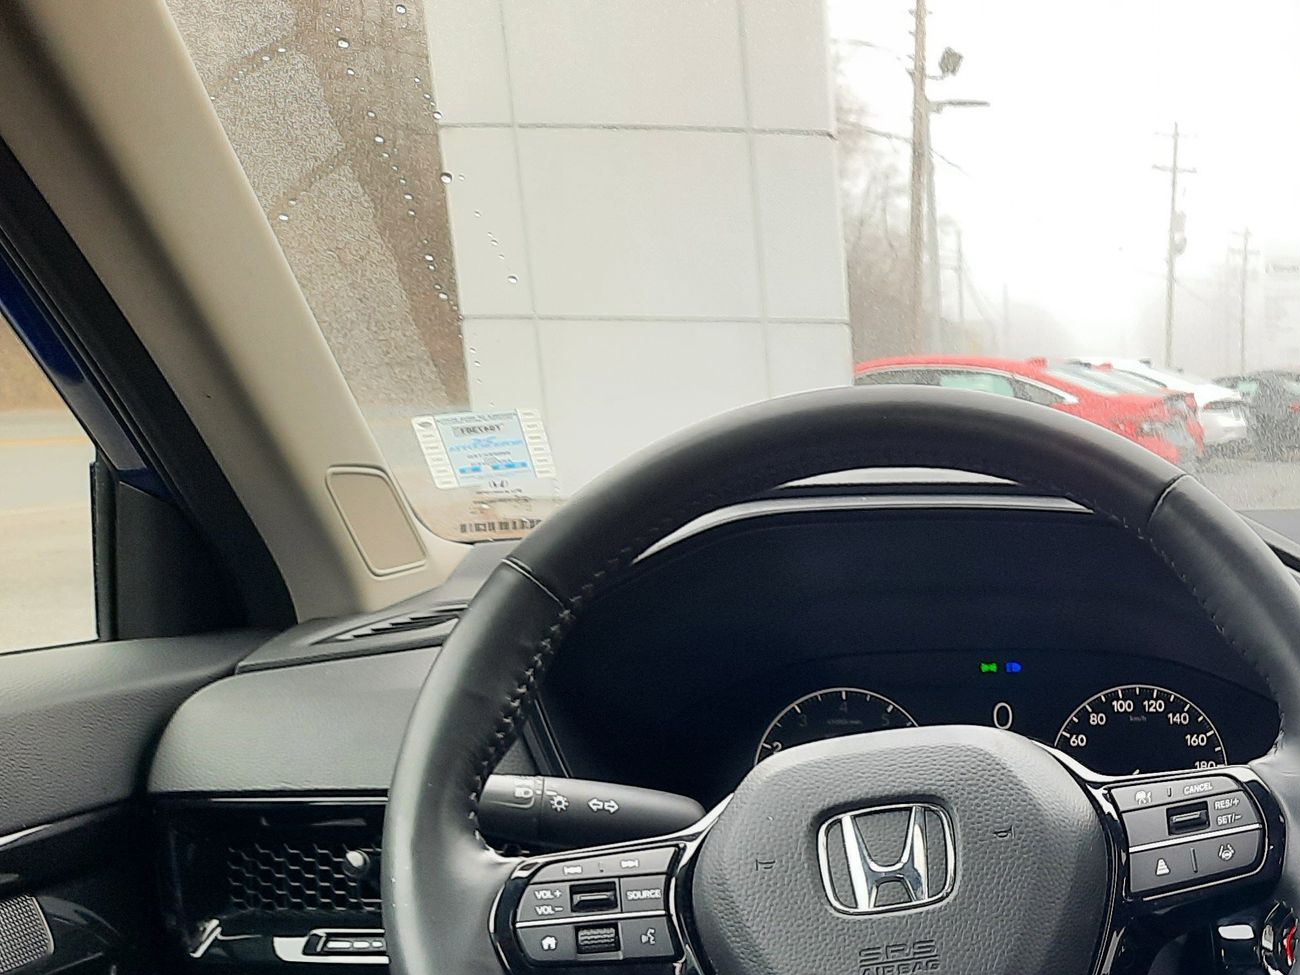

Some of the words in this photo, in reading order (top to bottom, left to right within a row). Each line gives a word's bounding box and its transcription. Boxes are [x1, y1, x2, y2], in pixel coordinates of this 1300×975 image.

[1112, 701, 1134, 713] 100
[1143, 700, 1165, 712] 120
[993, 702, 1012, 730] 0
[1089, 713, 1106, 725] 80
[1168, 713, 1189, 725] 140
[1070, 735, 1087, 747] 60
[1185, 735, 1207, 747] 160
[1183, 782, 1213, 796] CANCEL
[626, 889, 661, 900] SOURCE
[859, 939, 937, 963] SRS
